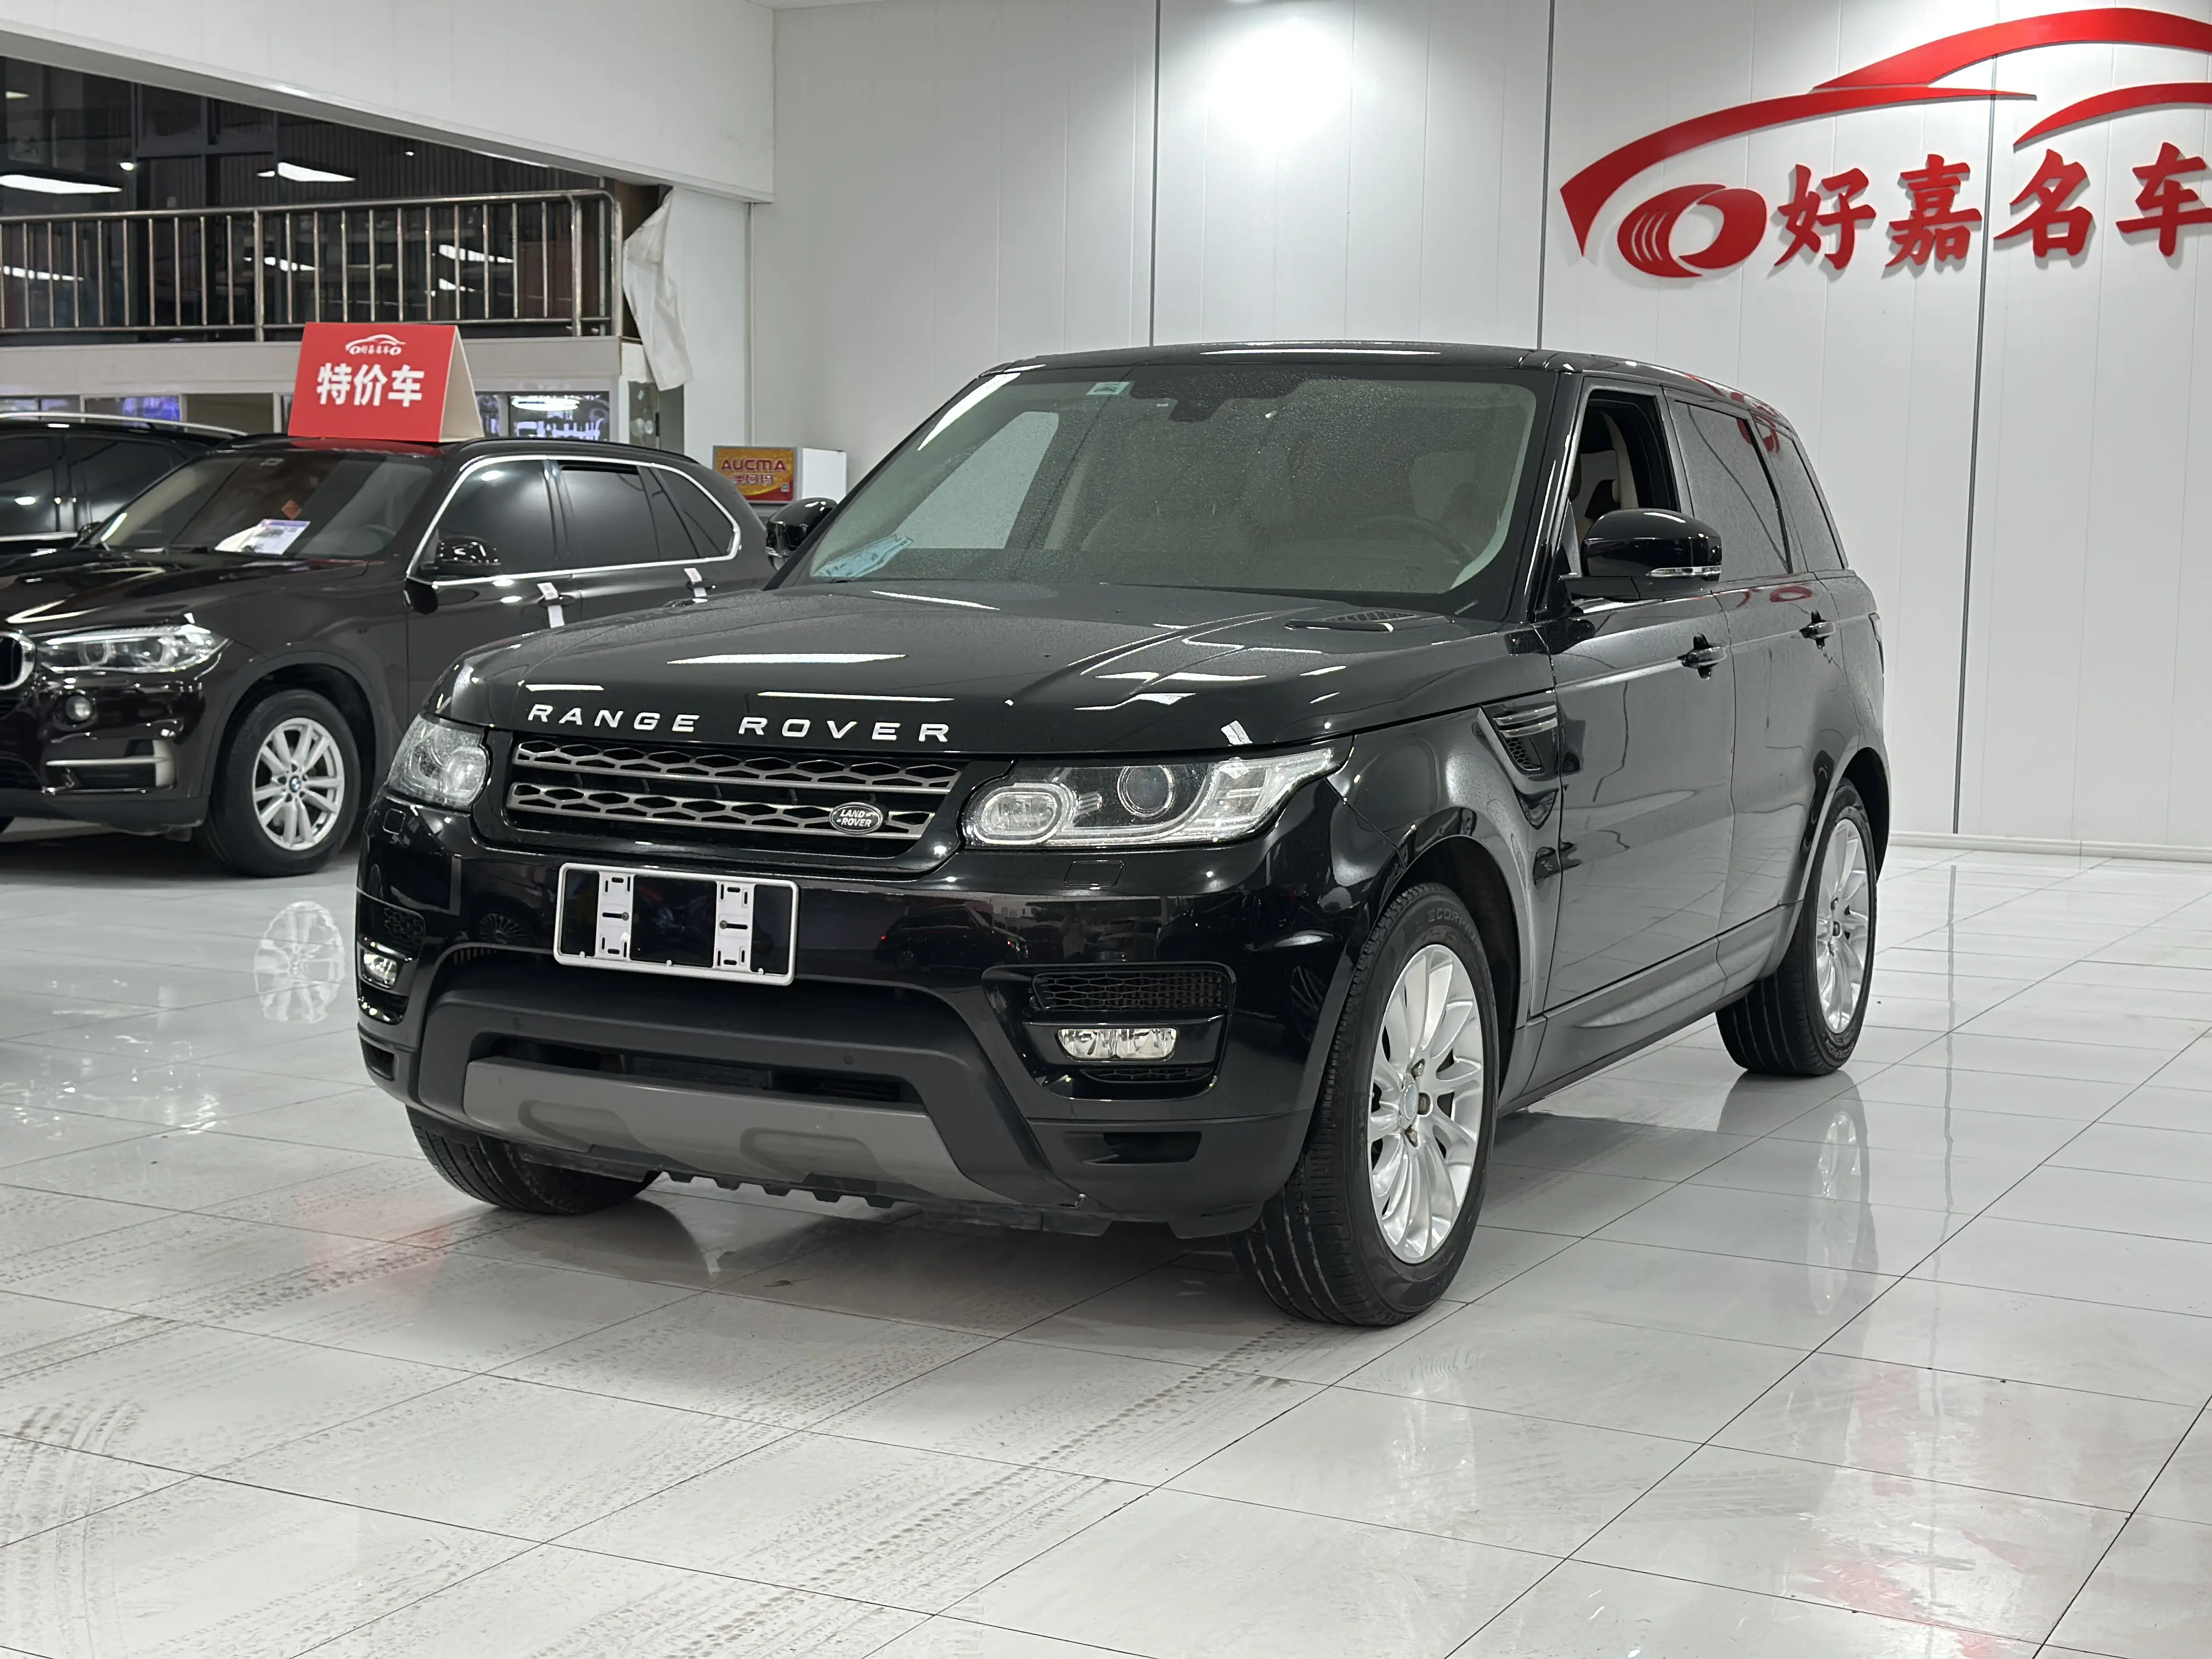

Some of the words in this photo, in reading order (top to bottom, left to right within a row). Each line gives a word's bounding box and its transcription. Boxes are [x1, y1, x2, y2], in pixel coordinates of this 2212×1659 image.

[1774, 142, 2212, 270] 好嘉名车
[317, 362, 425, 407] 特价车
[721, 458, 787, 472] AUCMA
[527, 704, 699, 732] RANGE
[738, 716, 949, 742] ROVER
[839, 809, 866, 818] LAND
[840, 817, 872, 827] ROVER
